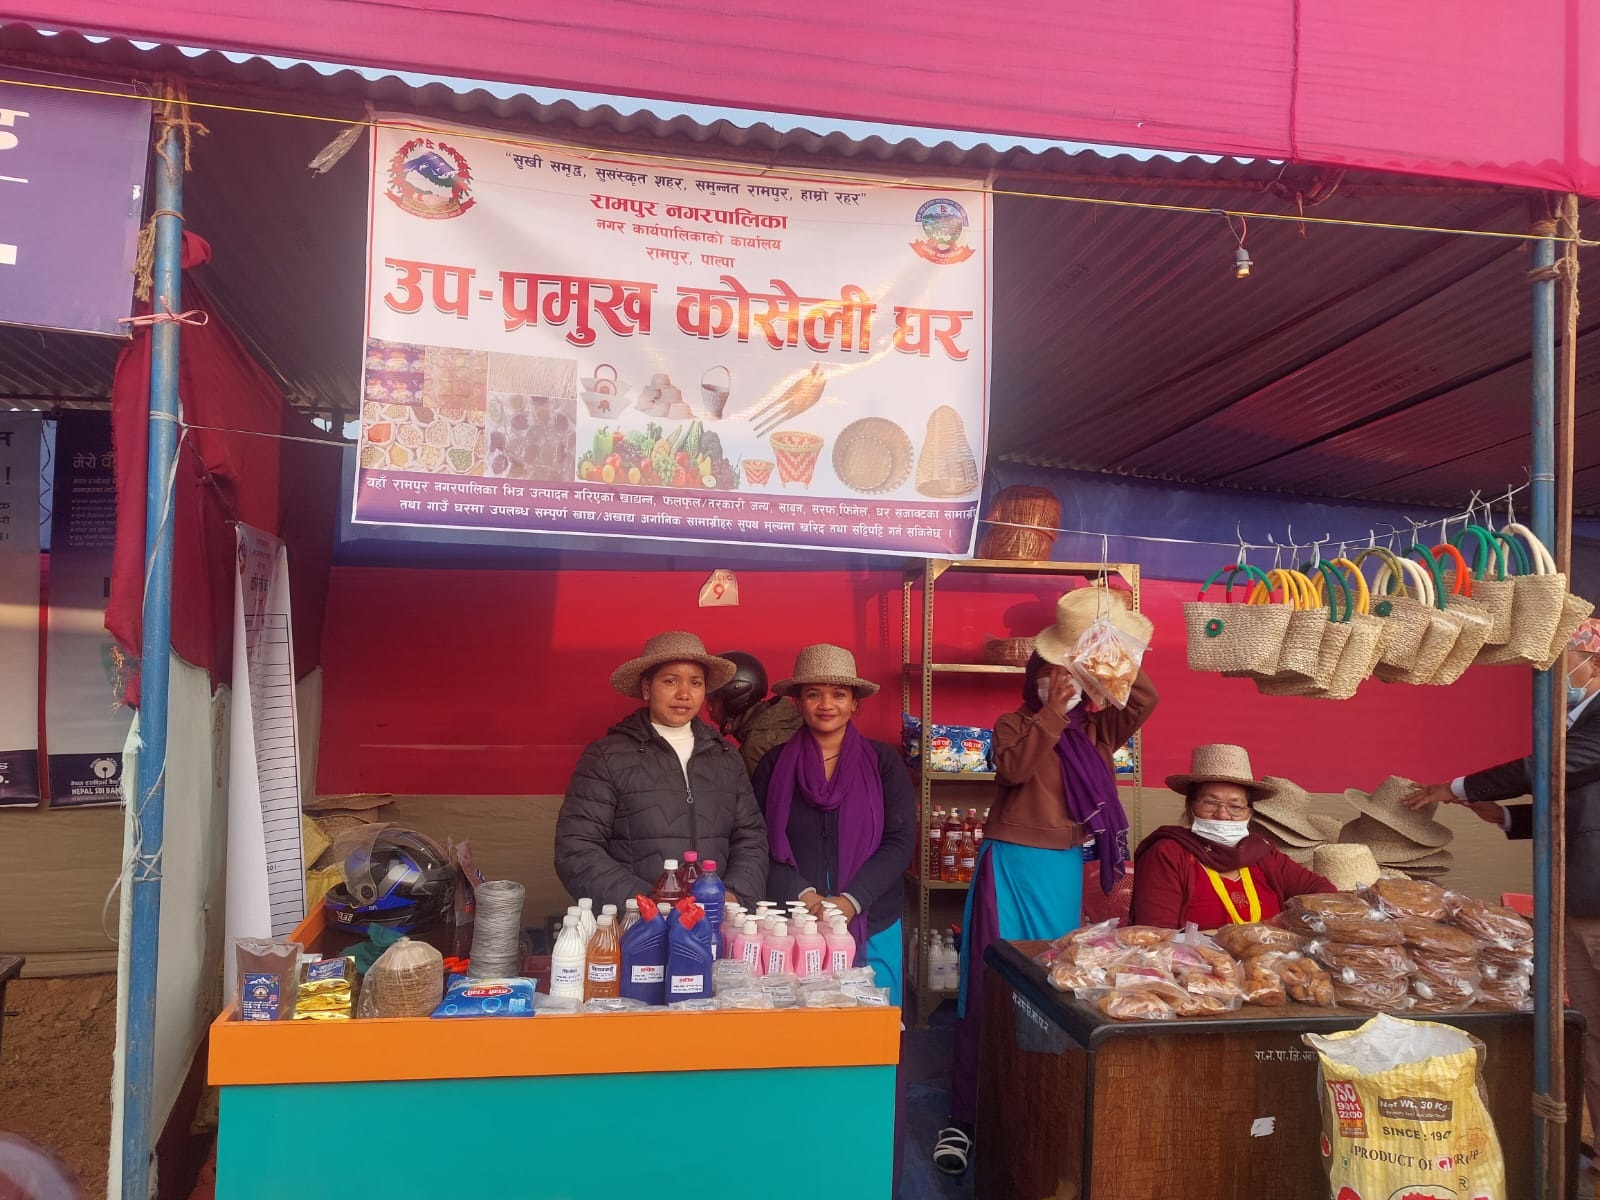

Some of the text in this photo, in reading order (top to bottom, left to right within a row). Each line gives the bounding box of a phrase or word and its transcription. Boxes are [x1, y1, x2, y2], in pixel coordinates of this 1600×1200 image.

[595, 168, 648, 187] सुसंस्कृत
[654, 175, 688, 191] शहर,
[695, 179, 740, 196] समुन्नत
[747, 185, 793, 202] रामपुर,
[801, 188, 829, 202] हाम्रो
[590, 194, 789, 230] रामपुर नगरपालिका
[596, 219, 782, 250] नगर कार्यपालिकाको कार्यालय
[645, 247, 736, 268] रामपुर, पाल्पा
[384, 256, 974, 361] उप-प्रमुख कोसेली घर
[366, 474, 387, 489] यहाँ
[392, 479, 430, 494] रामपुर
[434, 481, 498, 496] नगरपालिका
[502, 483, 525, 497] भित्र
[529, 487, 569, 501] उत्पादन
[574, 488, 615, 504] गरिएका
[875, 507, 890, 520] घर
[400, 499, 422, 511] तथा
[427, 497, 449, 512] गाउँ
[454, 503, 484, 515] घरमा
[489, 505, 530, 517] उपलब्ध
[800, 521, 825, 535] खरिद
[829, 525, 847, 536] तथा
[1331, 1083, 1356, 1102] ISO
[1420, 1101, 1433, 1110] 30
[1382, 1126, 1421, 1140] SINCE
[1353, 1145, 1415, 1168] PRODUCT
